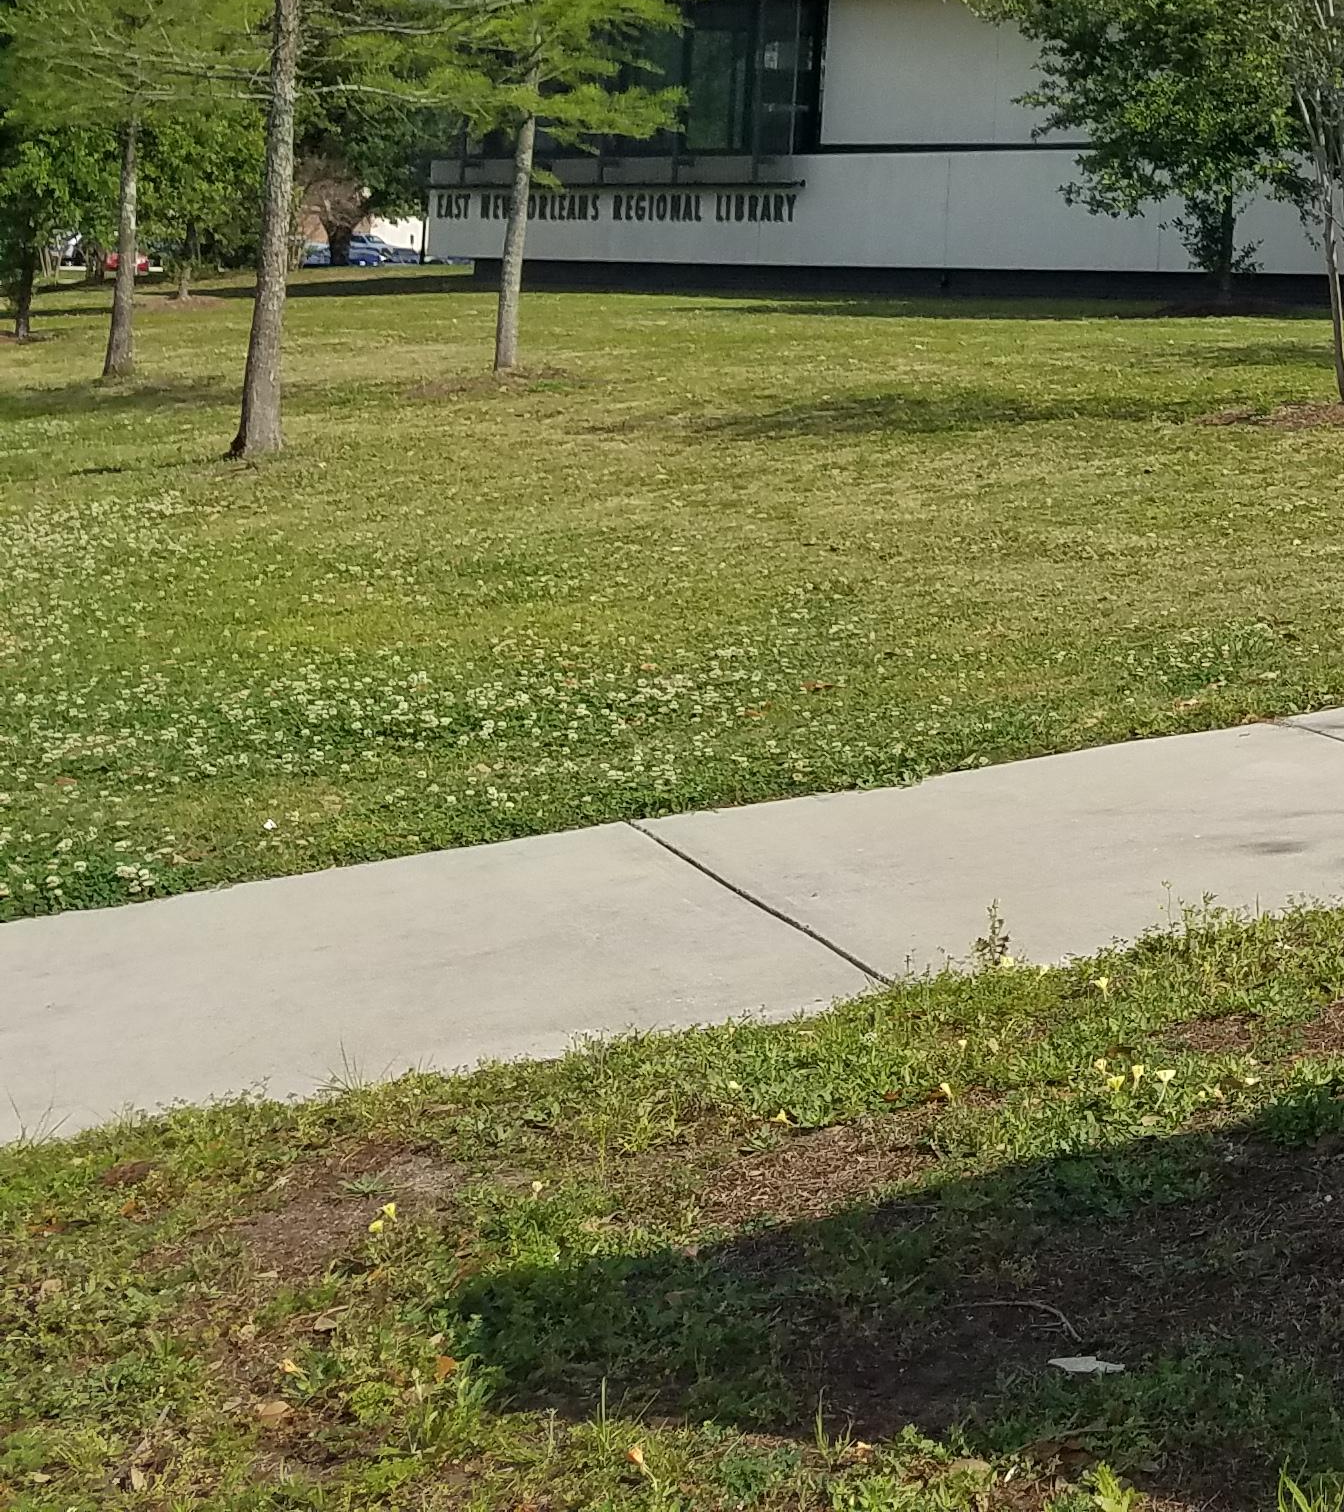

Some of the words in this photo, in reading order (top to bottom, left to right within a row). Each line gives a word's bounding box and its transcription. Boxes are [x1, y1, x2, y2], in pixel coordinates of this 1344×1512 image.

[436, 193, 471, 220] EAST
[527, 194, 600, 221] ORLEANS
[612, 194, 702, 222] REGIONAL
[715, 193, 797, 223] LIBRARY
